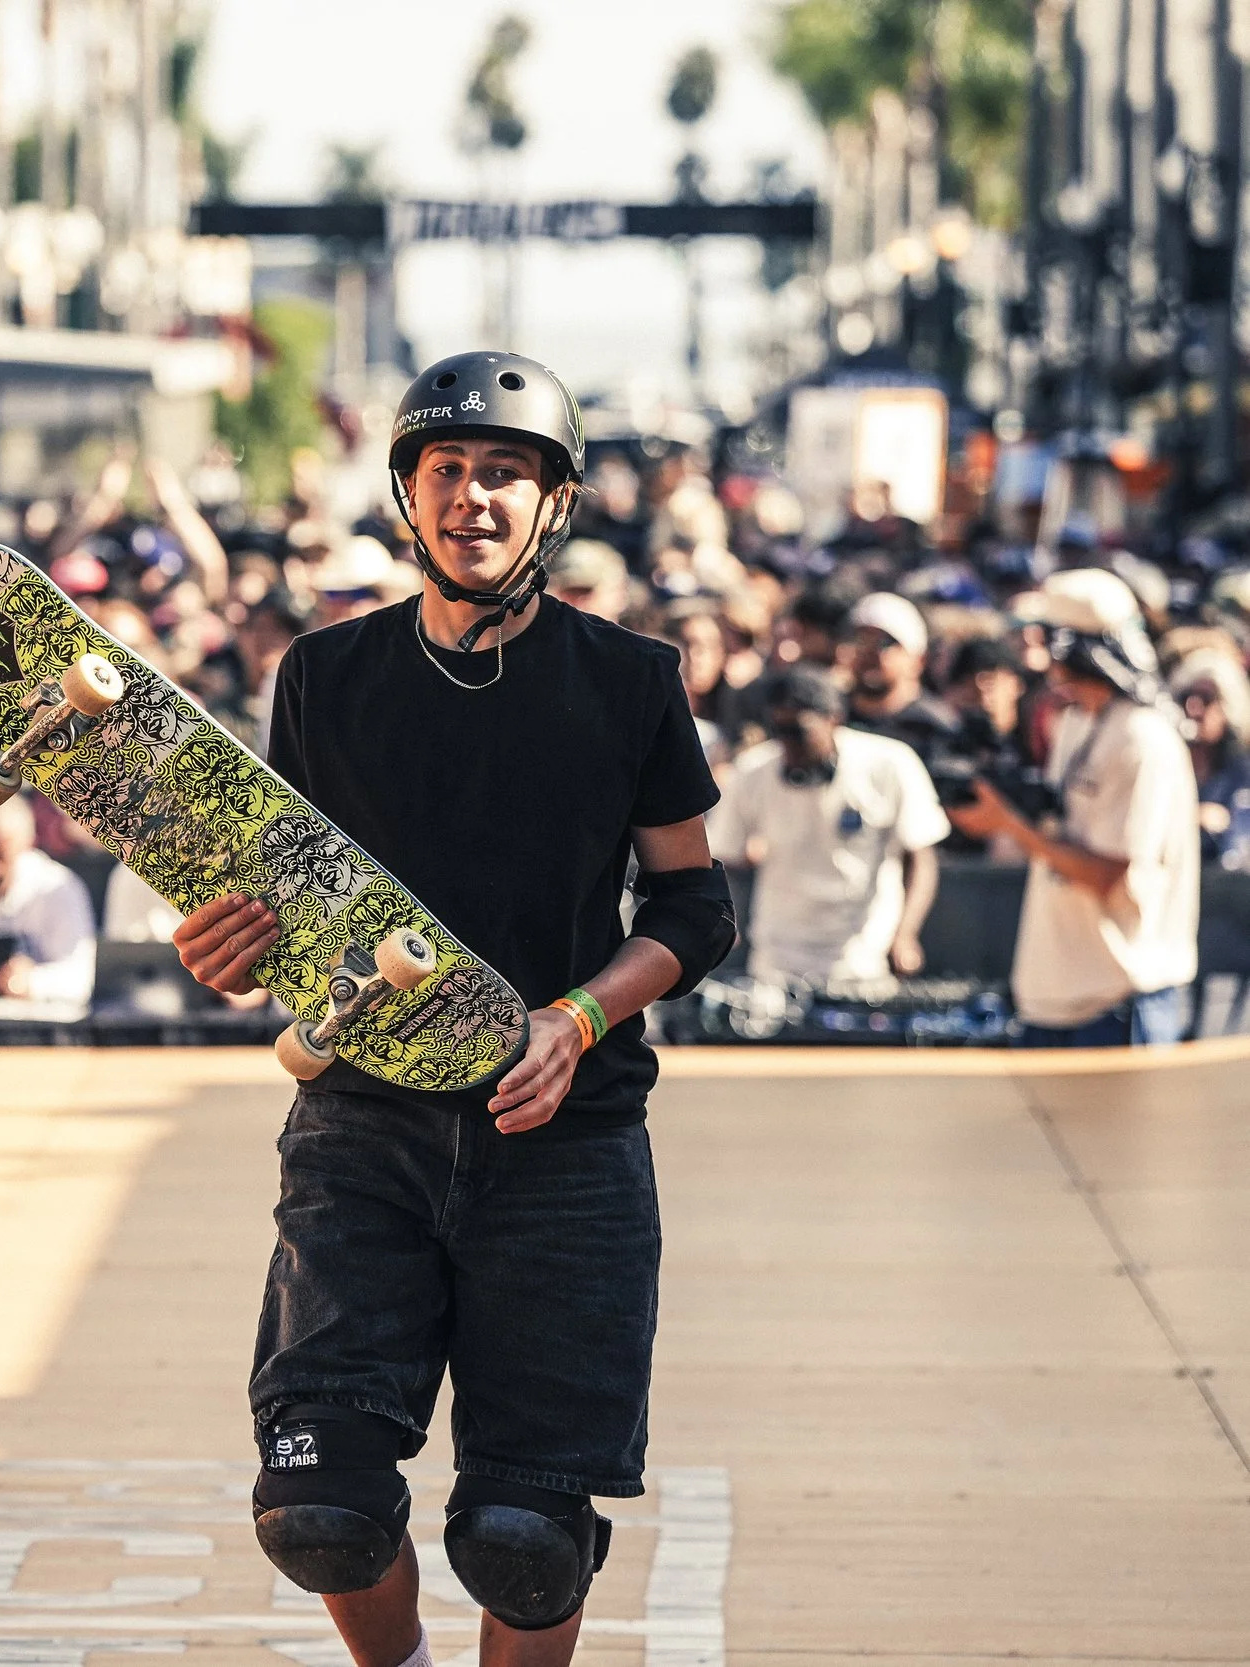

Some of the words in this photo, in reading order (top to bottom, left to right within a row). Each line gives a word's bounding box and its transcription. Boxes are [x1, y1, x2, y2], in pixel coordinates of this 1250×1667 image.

[394, 406, 453, 432] MONSTER
[401, 421, 427, 435] ARMY
[266, 1434, 314, 1455] 87
[289, 1453, 318, 1467] PADS
